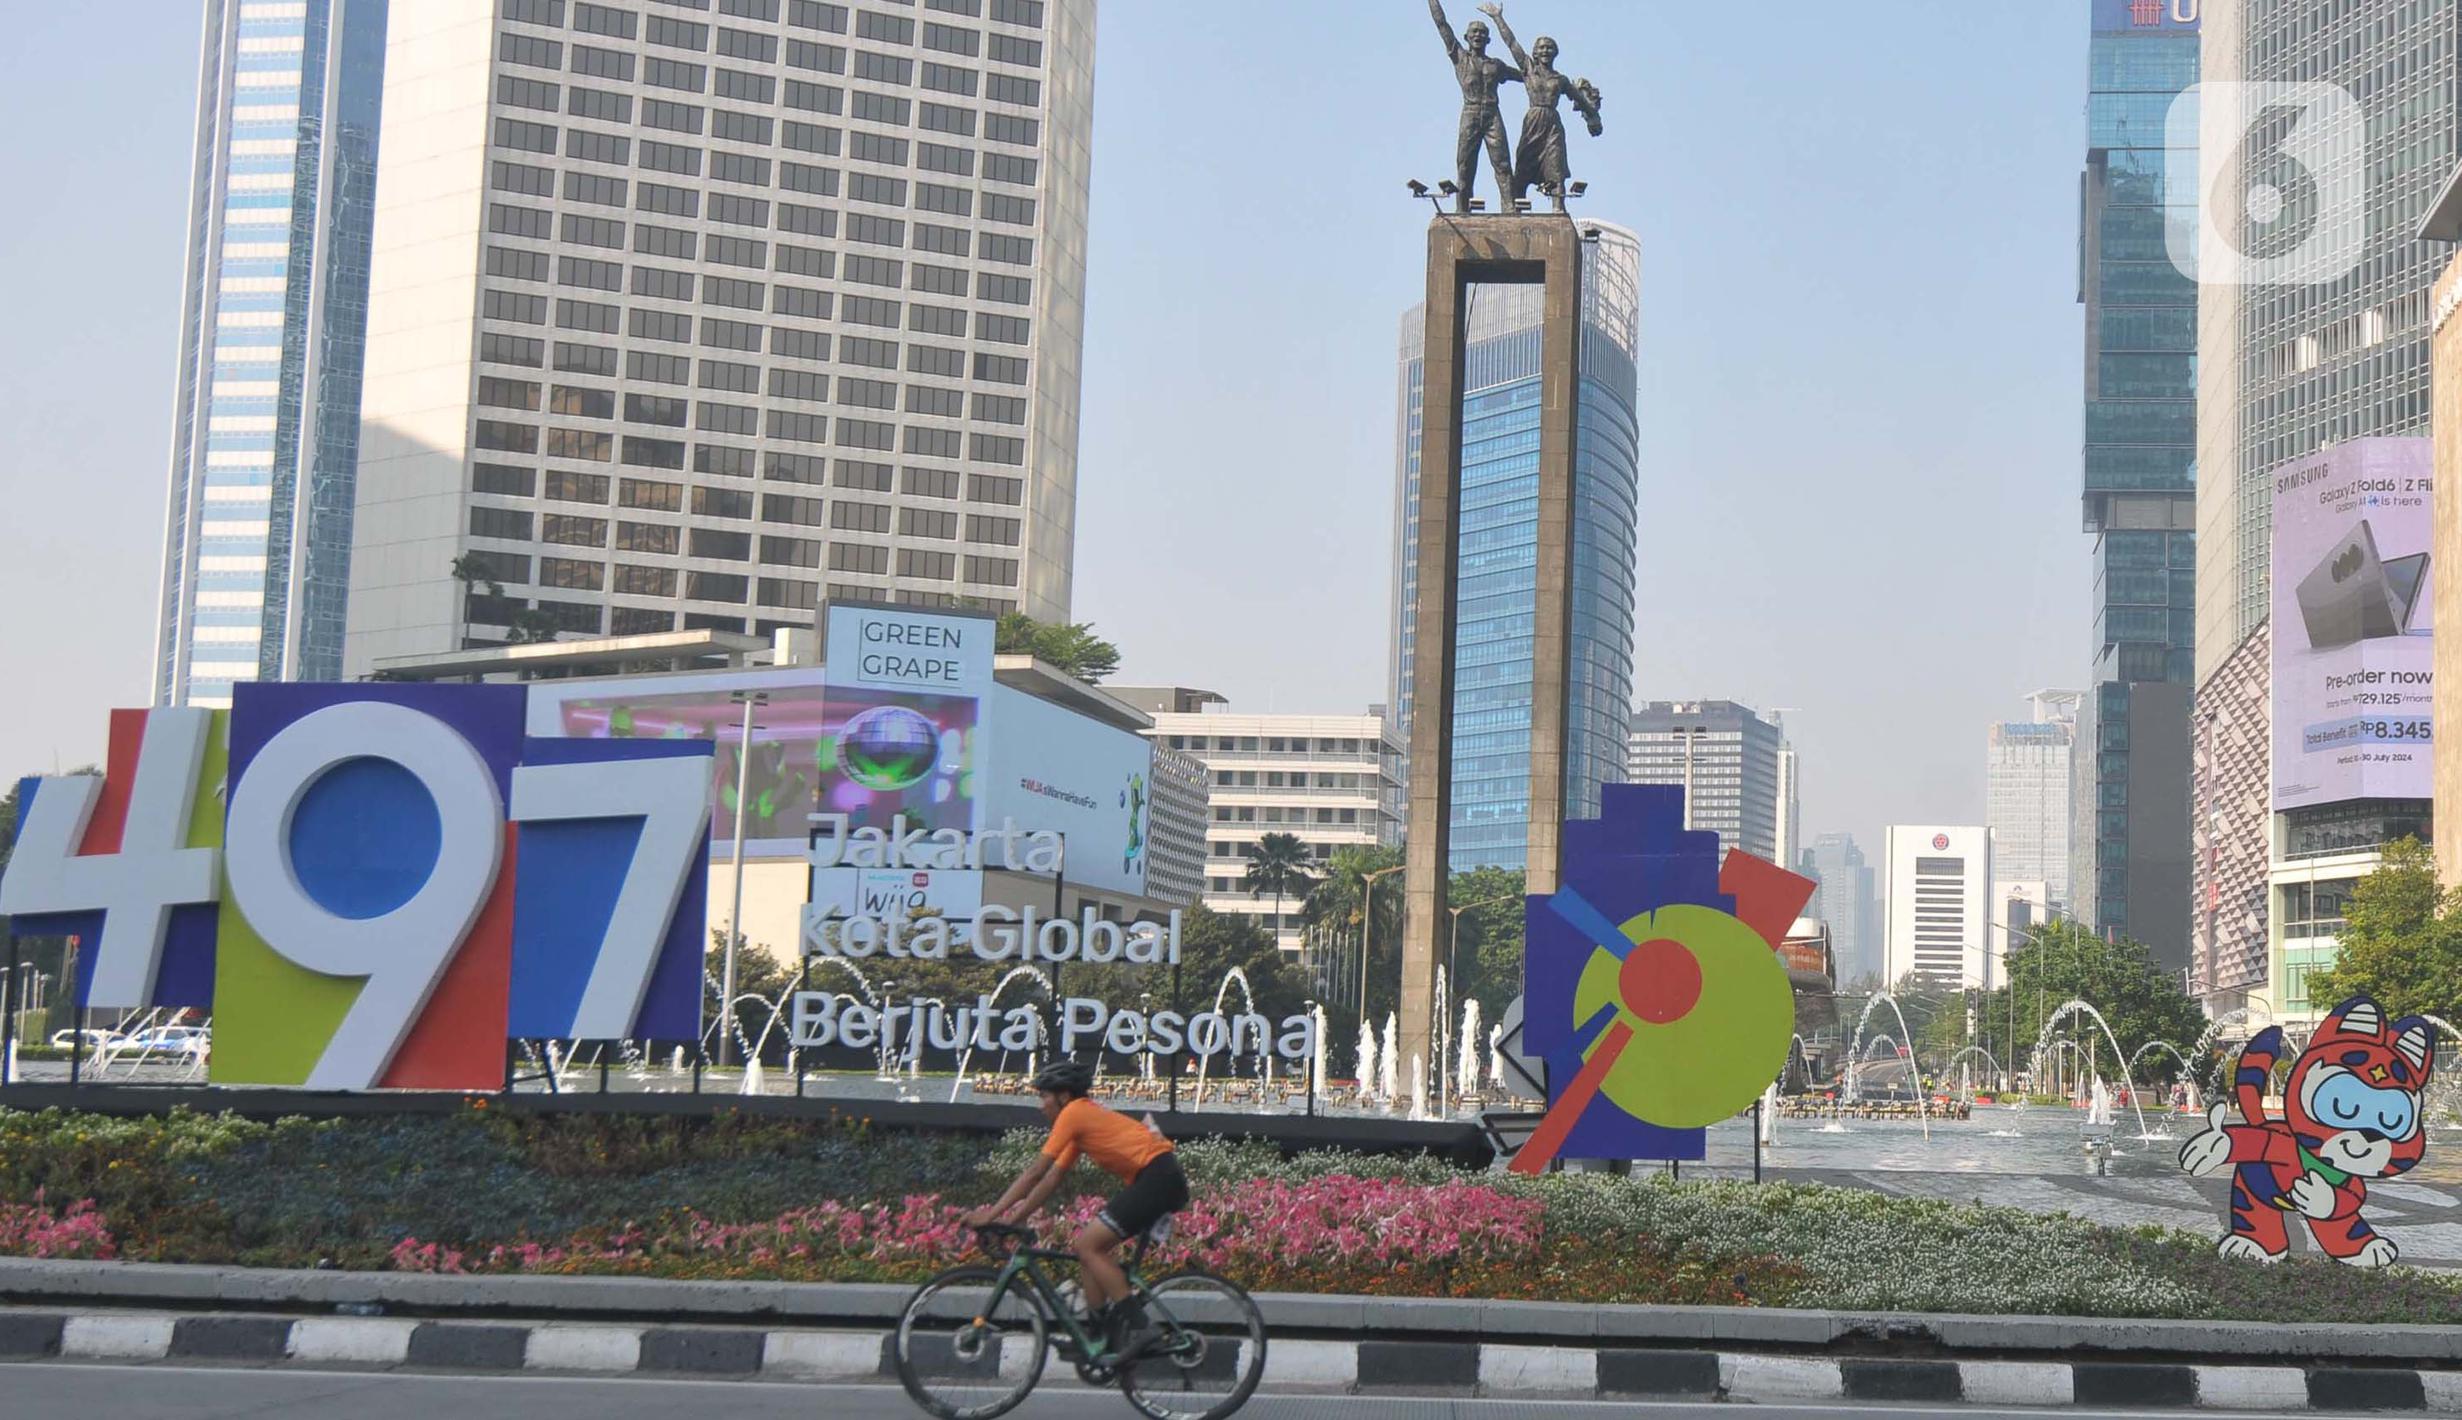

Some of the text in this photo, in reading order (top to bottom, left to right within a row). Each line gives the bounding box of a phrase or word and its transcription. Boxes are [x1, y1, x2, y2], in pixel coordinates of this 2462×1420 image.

[2277, 462, 2329, 494] SAMSUNG
[2319, 484, 2350, 505] Galaxy
[2357, 478, 2396, 492] Fold6
[2405, 478, 2414, 492] Z
[2393, 496, 2423, 506] here
[864, 621, 962, 649] GREEN
[862, 654, 960, 681] GRAPE
[2326, 668, 2433, 691] Pre-order now
[805, 812, 1065, 873] Jakarta
[799, 902, 1182, 965] Kota Global
[790, 990, 1316, 1062] Berjuta Pesona
